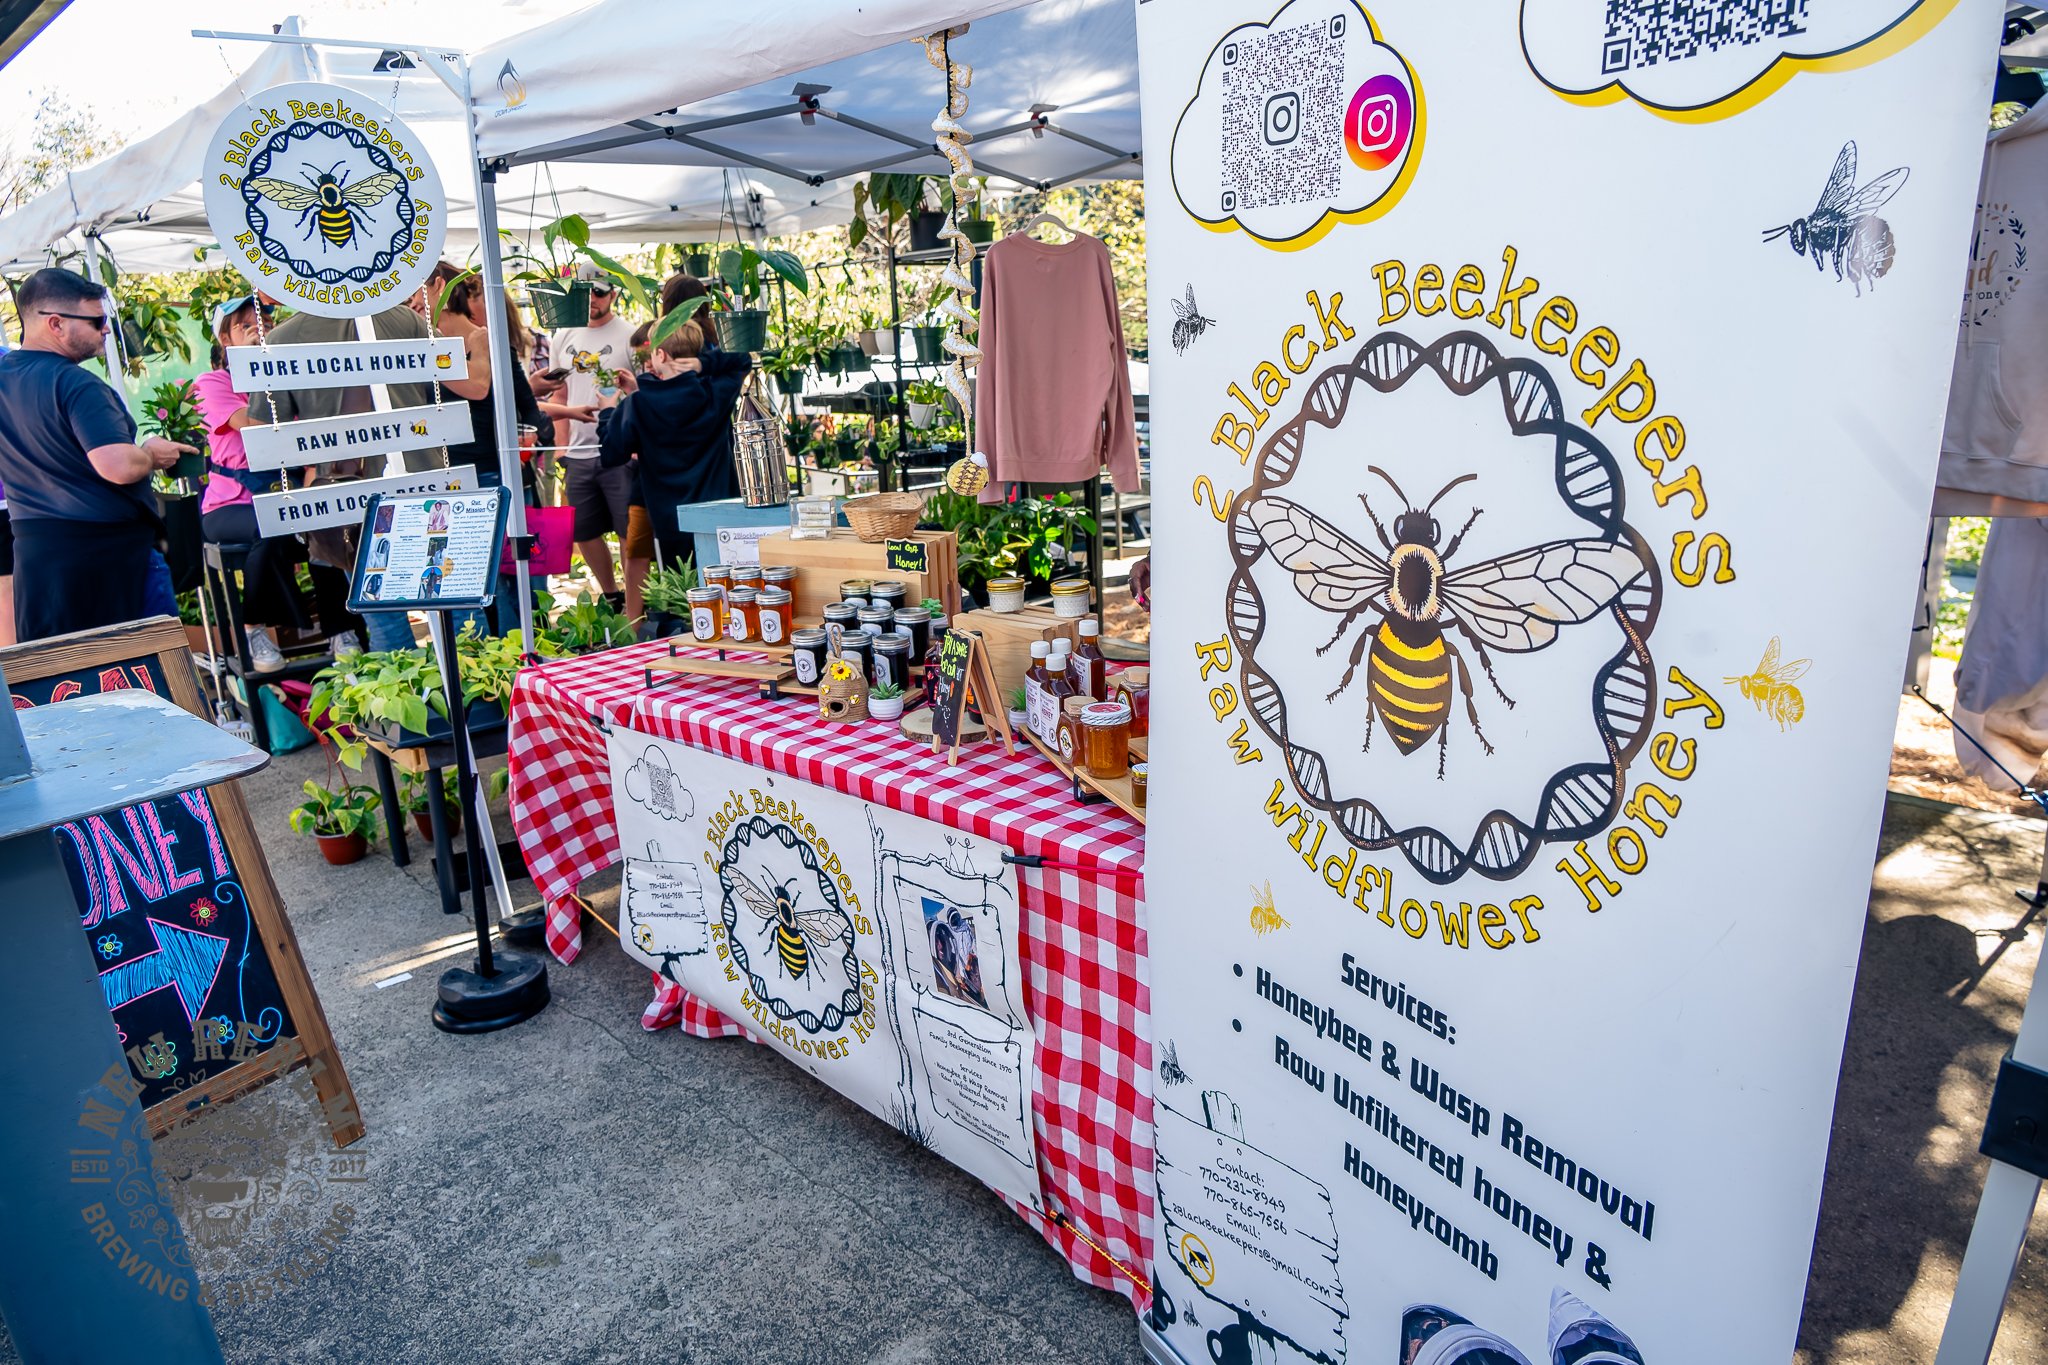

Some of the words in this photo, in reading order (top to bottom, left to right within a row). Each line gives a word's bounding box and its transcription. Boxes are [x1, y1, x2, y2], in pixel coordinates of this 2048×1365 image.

[224, 108, 285, 168] Black
[287, 99, 424, 182] Beekeepers
[220, 174, 240, 190] 2
[234, 230, 278, 277] Raw
[400, 199, 432, 268] Honey
[249, 360, 300, 378] PURE
[307, 356, 364, 375] LOCAL
[370, 354, 427, 372] HONEY
[1211, 288, 1355, 466] Black
[296, 432, 338, 452] RAW
[347, 424, 402, 444] HONEY
[1371, 244, 1736, 588] Beekeepers
[278, 502, 329, 522] FROM
[336, 492, 387, 512] LOC
[1193, 474, 1234, 523] 2
[1195, 633, 1264, 768] Raw
[1555, 664, 1727, 913] Honey
[706, 790, 749, 846] Black
[704, 850, 720, 874] 2
[750, 788, 873, 936] Beekeepers
[710, 920, 740, 982] Raw
[850, 960, 878, 1044] Honey
[1340, 952, 1456, 1046] Services:
[930, 1032, 948, 1048] Family
[949, 1041, 980, 1062] Beekeeping
[999, 1064, 1012, 1074] 1970
[958, 1036, 992, 1055] Generation
[954, 1080, 981, 1096] Unfiltered
[969, 1078, 982, 1092] Wasp
[984, 1084, 1008, 1102] Removal
[1256, 966, 1372, 1062] Honeybee
[1380, 1039, 1401, 1081] &
[1410, 1056, 1491, 1138] Wasp
[1500, 1112, 1656, 1242] Removal
[1216, 1158, 1264, 1188] Contact:
[1274, 1034, 1326, 1094] Raw
[1332, 1072, 1464, 1190] Unfiltered
[1472, 1165, 1574, 1268] honey
[1584, 1240, 1613, 1292] &
[1199, 1166, 1286, 1214] 770-231-8949
[1204, 1186, 1287, 1236] 770-865-7556
[1343, 1140, 1499, 1282] Honeycomb
[1172, 1202, 1330, 1299] 2BlackBeekeepers@gmail.com
[1226, 1214, 1261, 1241] Email:
